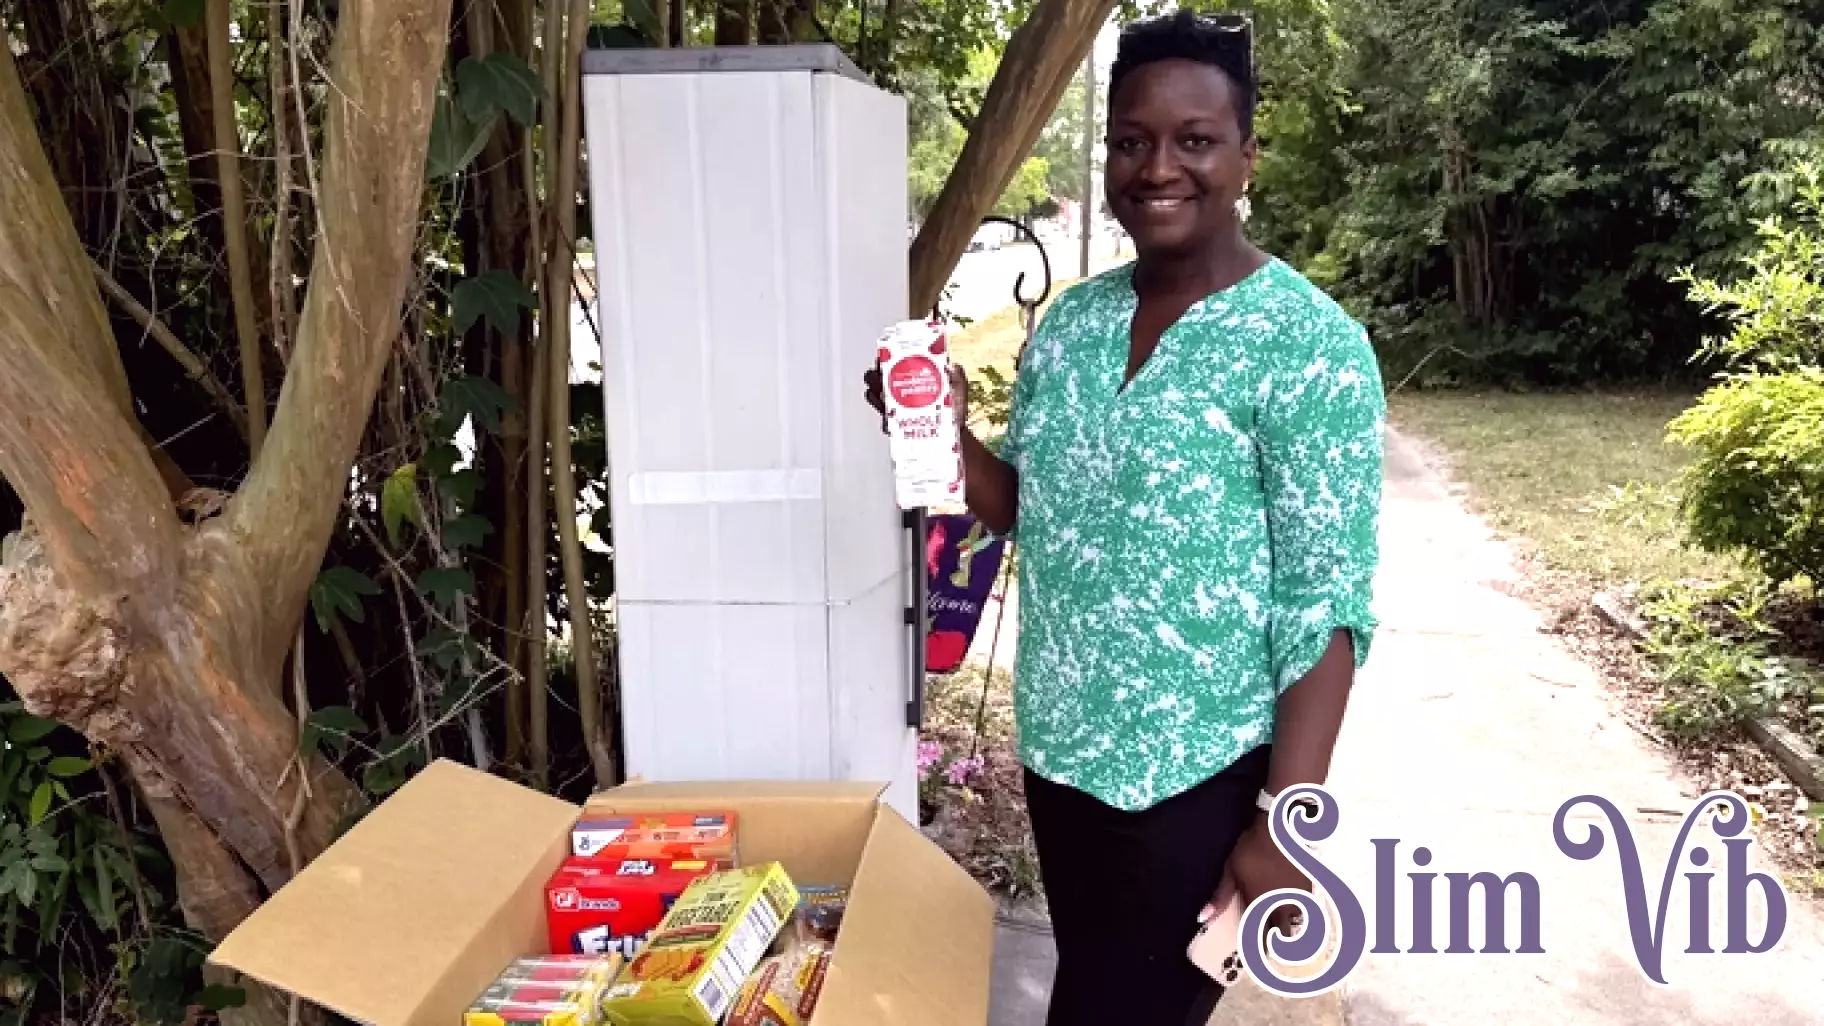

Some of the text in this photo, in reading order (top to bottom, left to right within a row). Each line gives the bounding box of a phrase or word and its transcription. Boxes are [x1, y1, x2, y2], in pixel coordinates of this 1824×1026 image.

[897, 413, 942, 429] WHOLE
[903, 428, 939, 440] MILK
[928, 590, 977, 614] lcome
